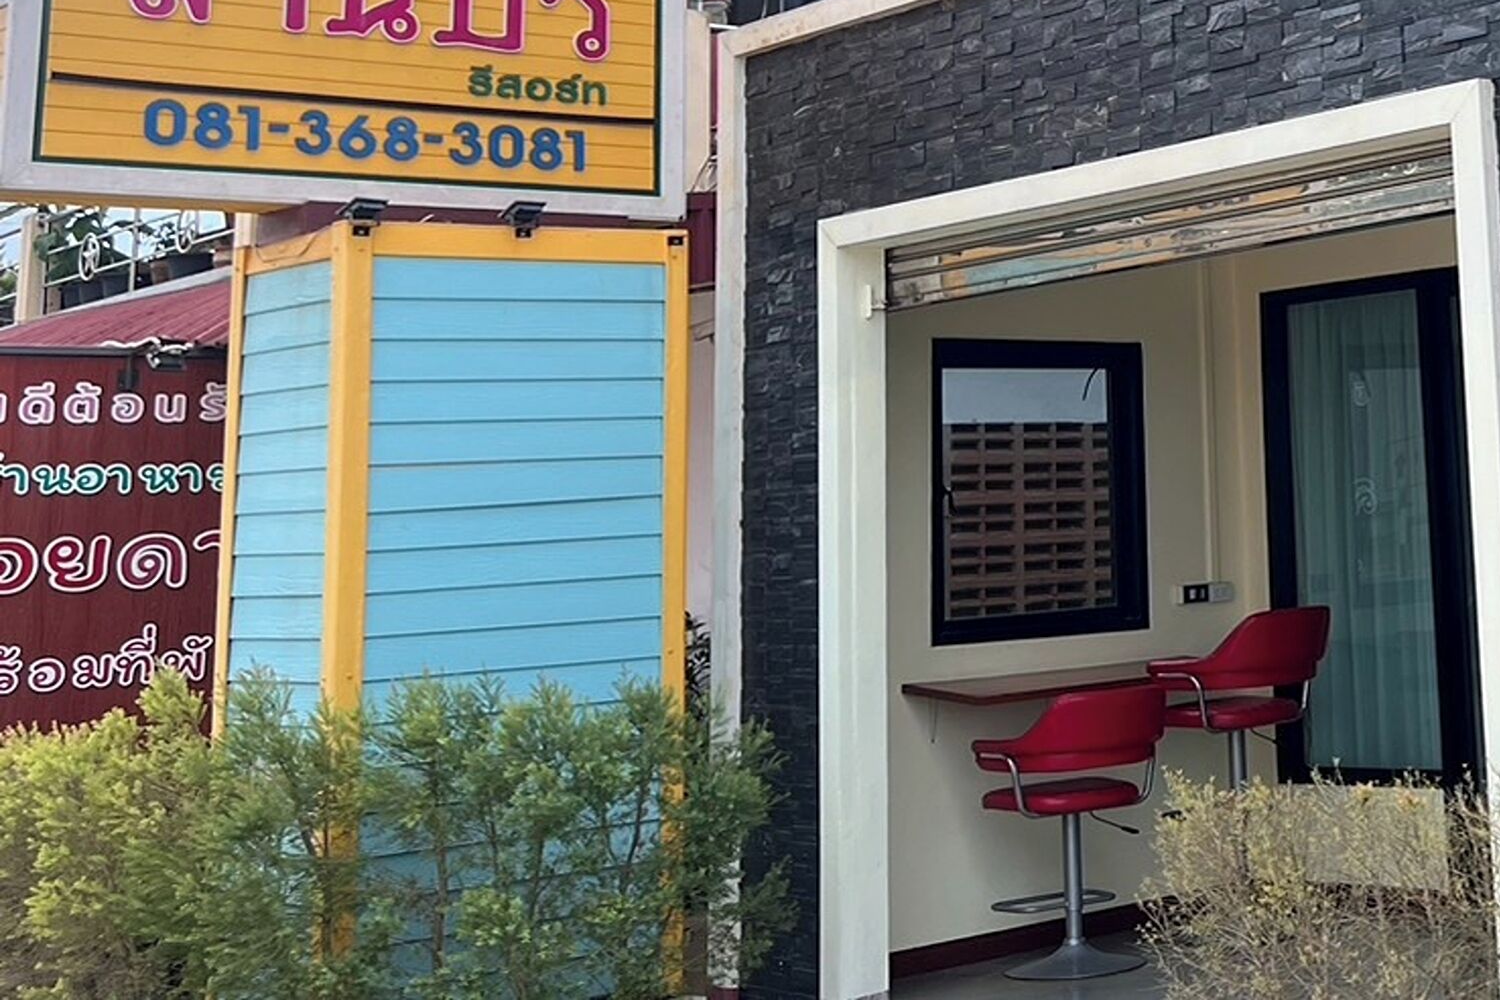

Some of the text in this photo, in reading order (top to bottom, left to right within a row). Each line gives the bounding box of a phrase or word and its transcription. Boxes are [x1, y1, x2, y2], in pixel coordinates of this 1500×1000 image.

[468, 64, 607, 106] รีสอร์ท
[143, 99, 588, 173] 081-368-3081
